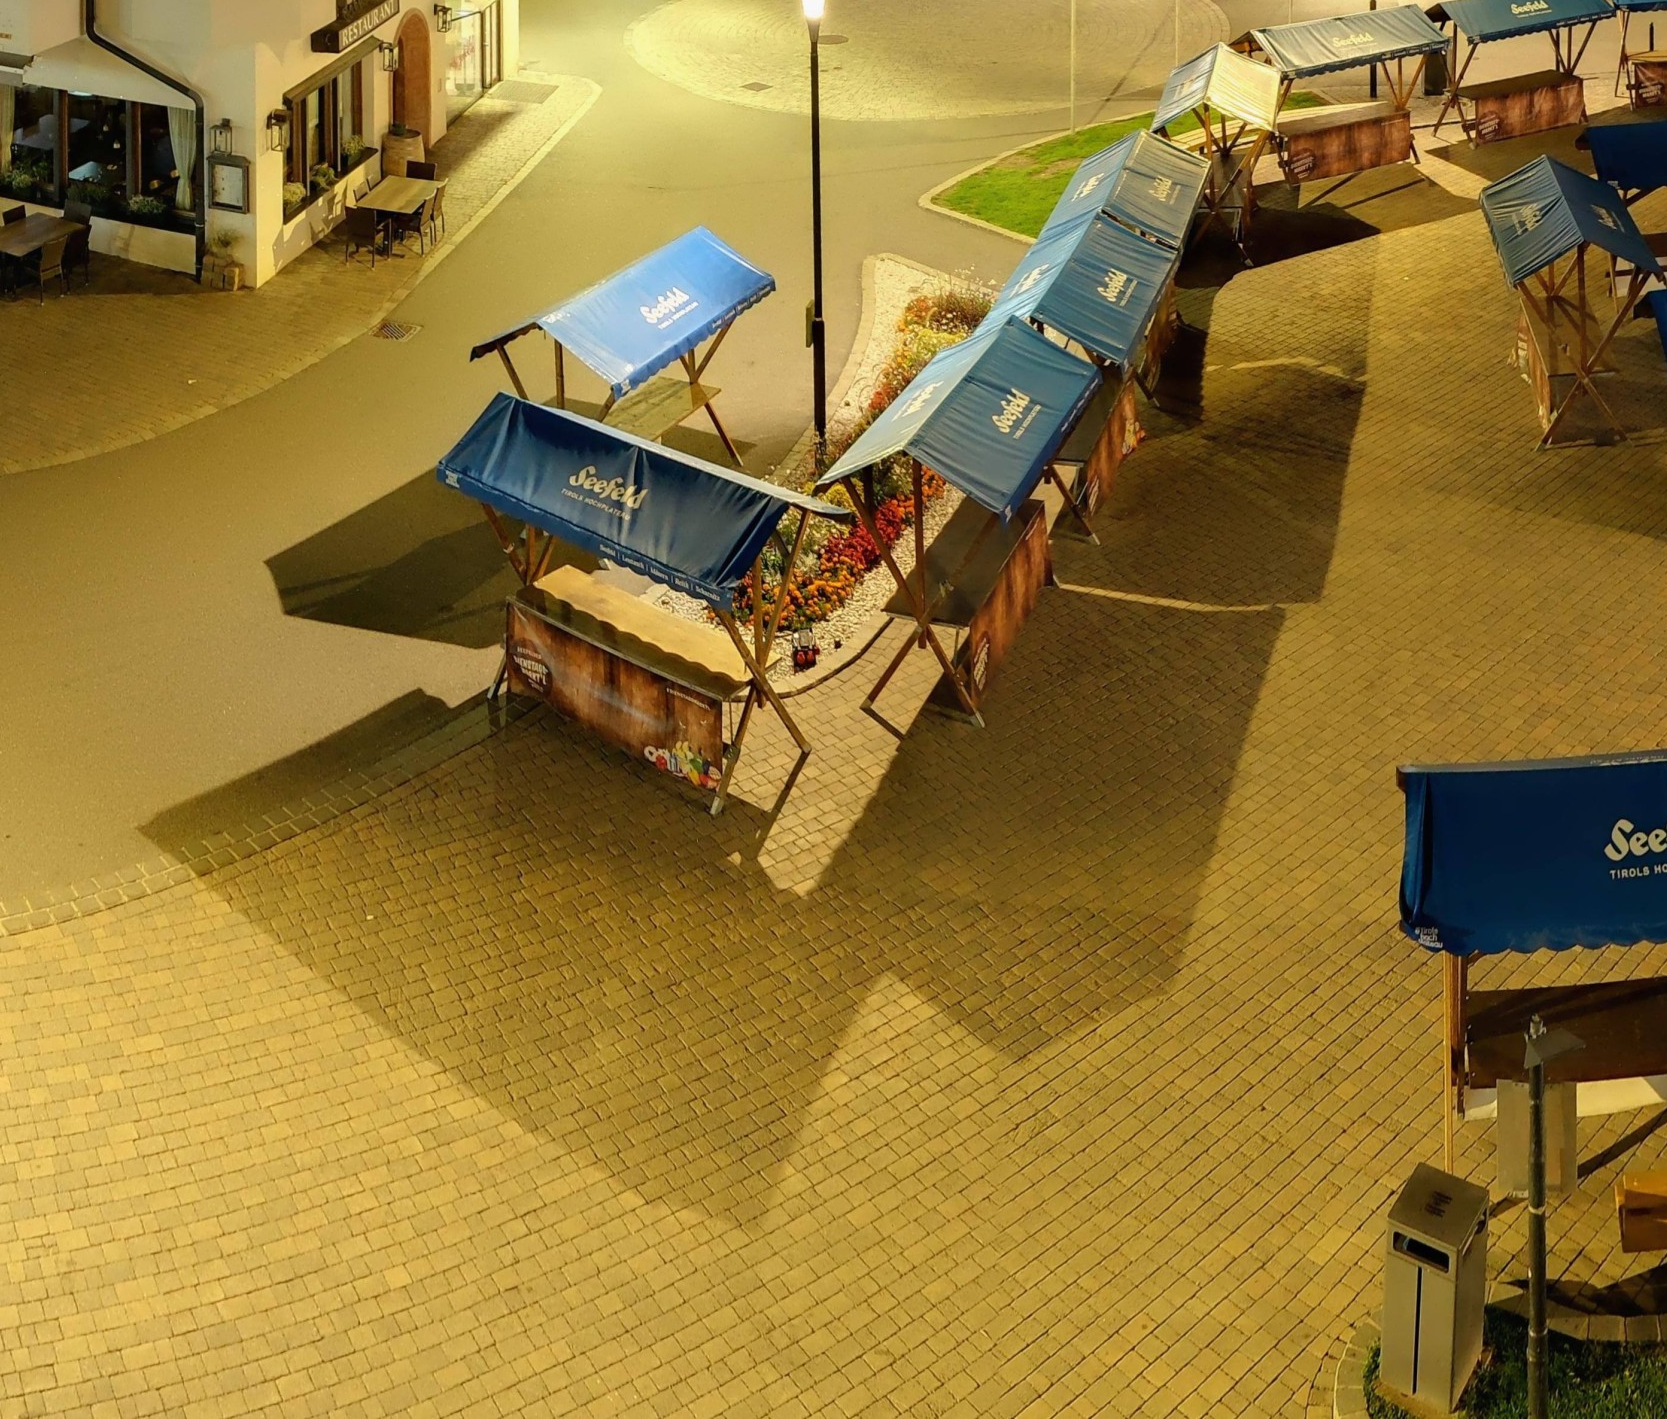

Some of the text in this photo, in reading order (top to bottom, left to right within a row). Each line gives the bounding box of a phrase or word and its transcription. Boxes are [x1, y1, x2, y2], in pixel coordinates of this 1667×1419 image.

[1511, 0, 1548, 15] Seefeld
[1333, 32, 1374, 48] Seefeld
[640, 287, 690, 324] Seefeld
[992, 388, 1030, 433] Seefeld
[561, 487, 584, 502] TIROLS
[569, 465, 648, 509] Seefeld
[1609, 866, 1650, 880] TIROLS
